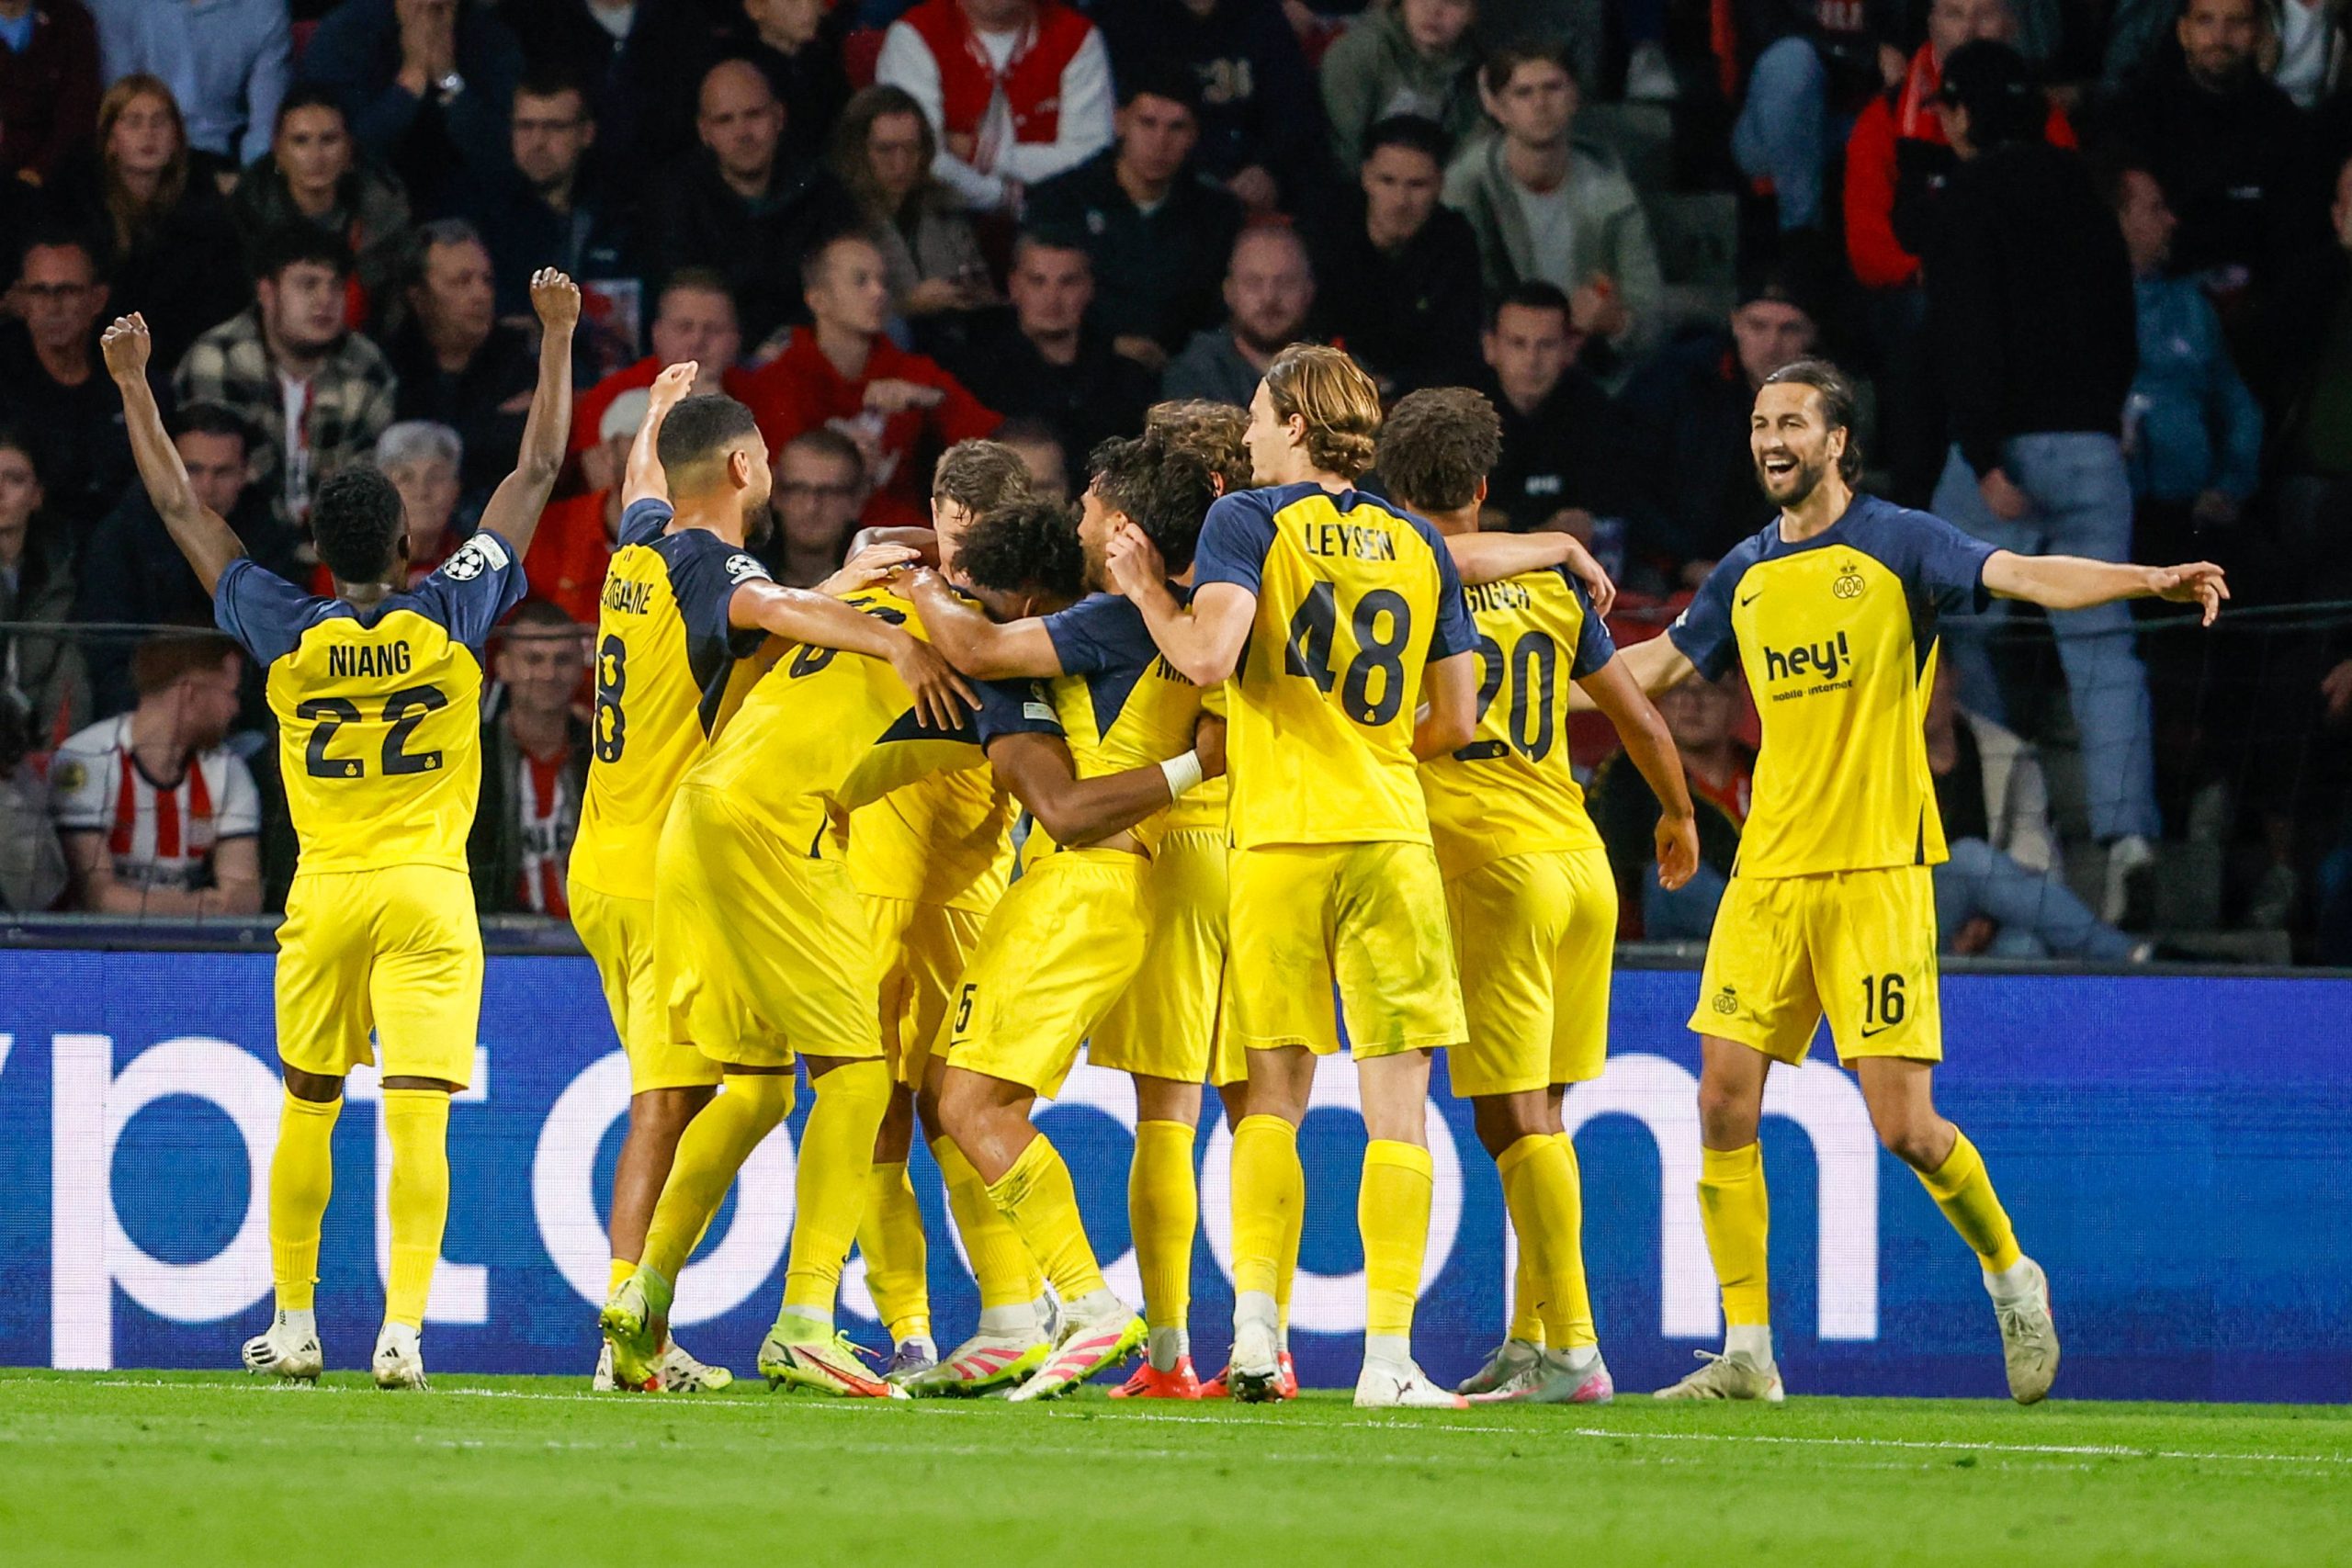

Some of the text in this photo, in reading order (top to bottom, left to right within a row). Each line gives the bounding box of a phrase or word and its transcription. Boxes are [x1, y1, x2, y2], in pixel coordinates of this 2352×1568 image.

[1306, 523, 1396, 561] LEYSEN
[328, 640, 412, 678] NIANG
[1286, 581, 1411, 727] 48
[1764, 631, 1851, 682] hey!
[1453, 632, 1555, 763] 20
[1772, 680, 1853, 702] mobile internet
[297, 685, 448, 778] 22
[954, 983, 978, 1033] 5
[1861, 973, 1905, 1025] 16
